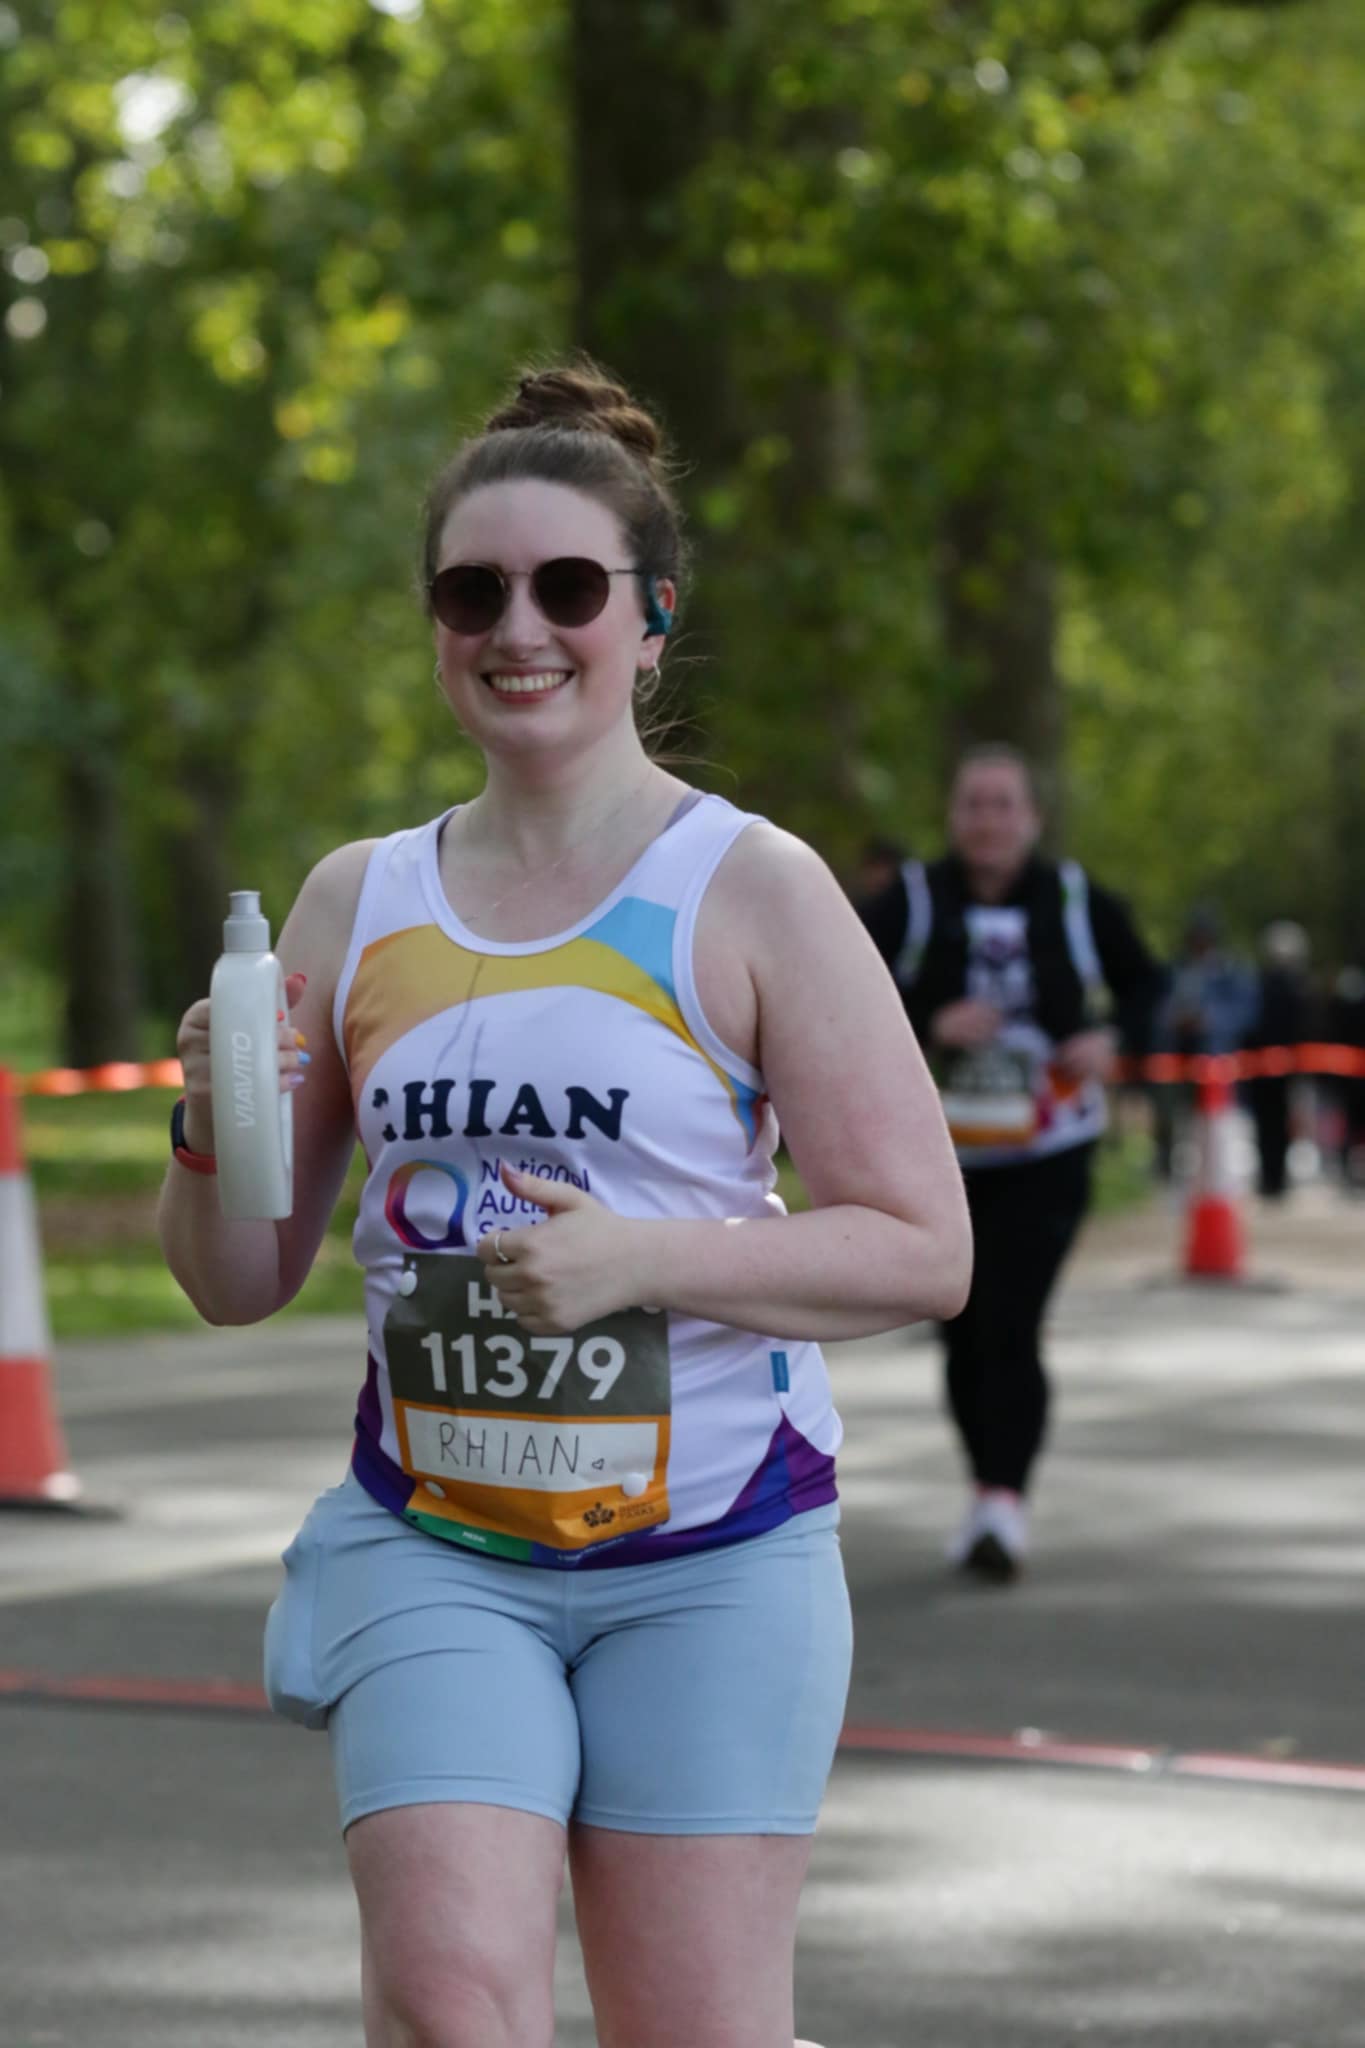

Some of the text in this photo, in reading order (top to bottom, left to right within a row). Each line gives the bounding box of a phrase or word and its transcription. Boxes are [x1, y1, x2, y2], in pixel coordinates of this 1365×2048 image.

[232, 1031, 256, 1128] VIAVITO
[480, 1158, 590, 1193] Ntional
[420, 1333, 626, 1400] 11379
[439, 1422, 580, 1475] RHIAN
